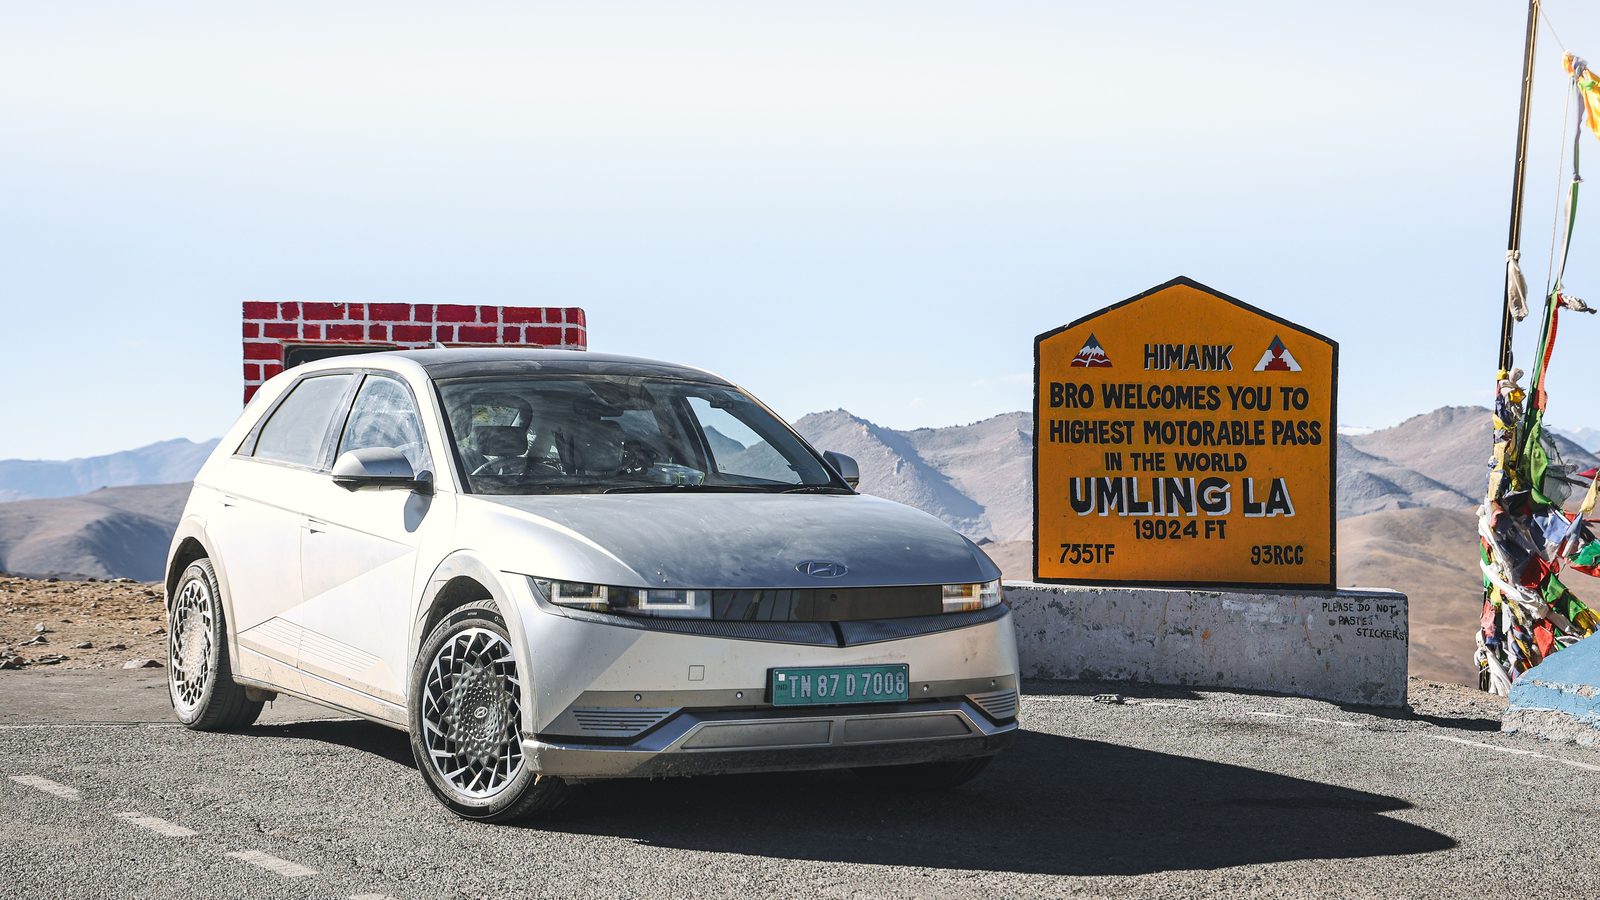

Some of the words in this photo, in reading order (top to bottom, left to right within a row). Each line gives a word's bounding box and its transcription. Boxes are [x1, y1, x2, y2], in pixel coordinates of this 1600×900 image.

[1144, 343, 1234, 371] HIMANK
[1050, 382, 1095, 408] BRO
[1101, 383, 1221, 411] WELCOMES
[1226, 386, 1272, 411] YOU
[1280, 387, 1309, 411] TO
[1049, 420, 1135, 444] HIGHEST
[1143, 420, 1265, 446] MOTORABLE
[1271, 421, 1322, 445] PASS
[1104, 452, 1122, 471] IN
[1130, 452, 1166, 472] THE
[1174, 452, 1247, 472] WORLD
[1069, 476, 1231, 517] UMLING
[1242, 477, 1296, 518] LA
[1133, 519, 1198, 540] 19024
[1204, 520, 1227, 539] FT
[1060, 543, 1116, 565] 755TF
[1250, 544, 1304, 565] 93RCC
[1322, 602, 1354, 612] PLEASE
[1357, 603, 1371, 612] DO
[1356, 627, 1406, 641] STICKERS
[788, 674, 812, 698] TN
[817, 674, 840, 697] 87
[846, 673, 856, 696] D
[861, 671, 905, 696] 7008
